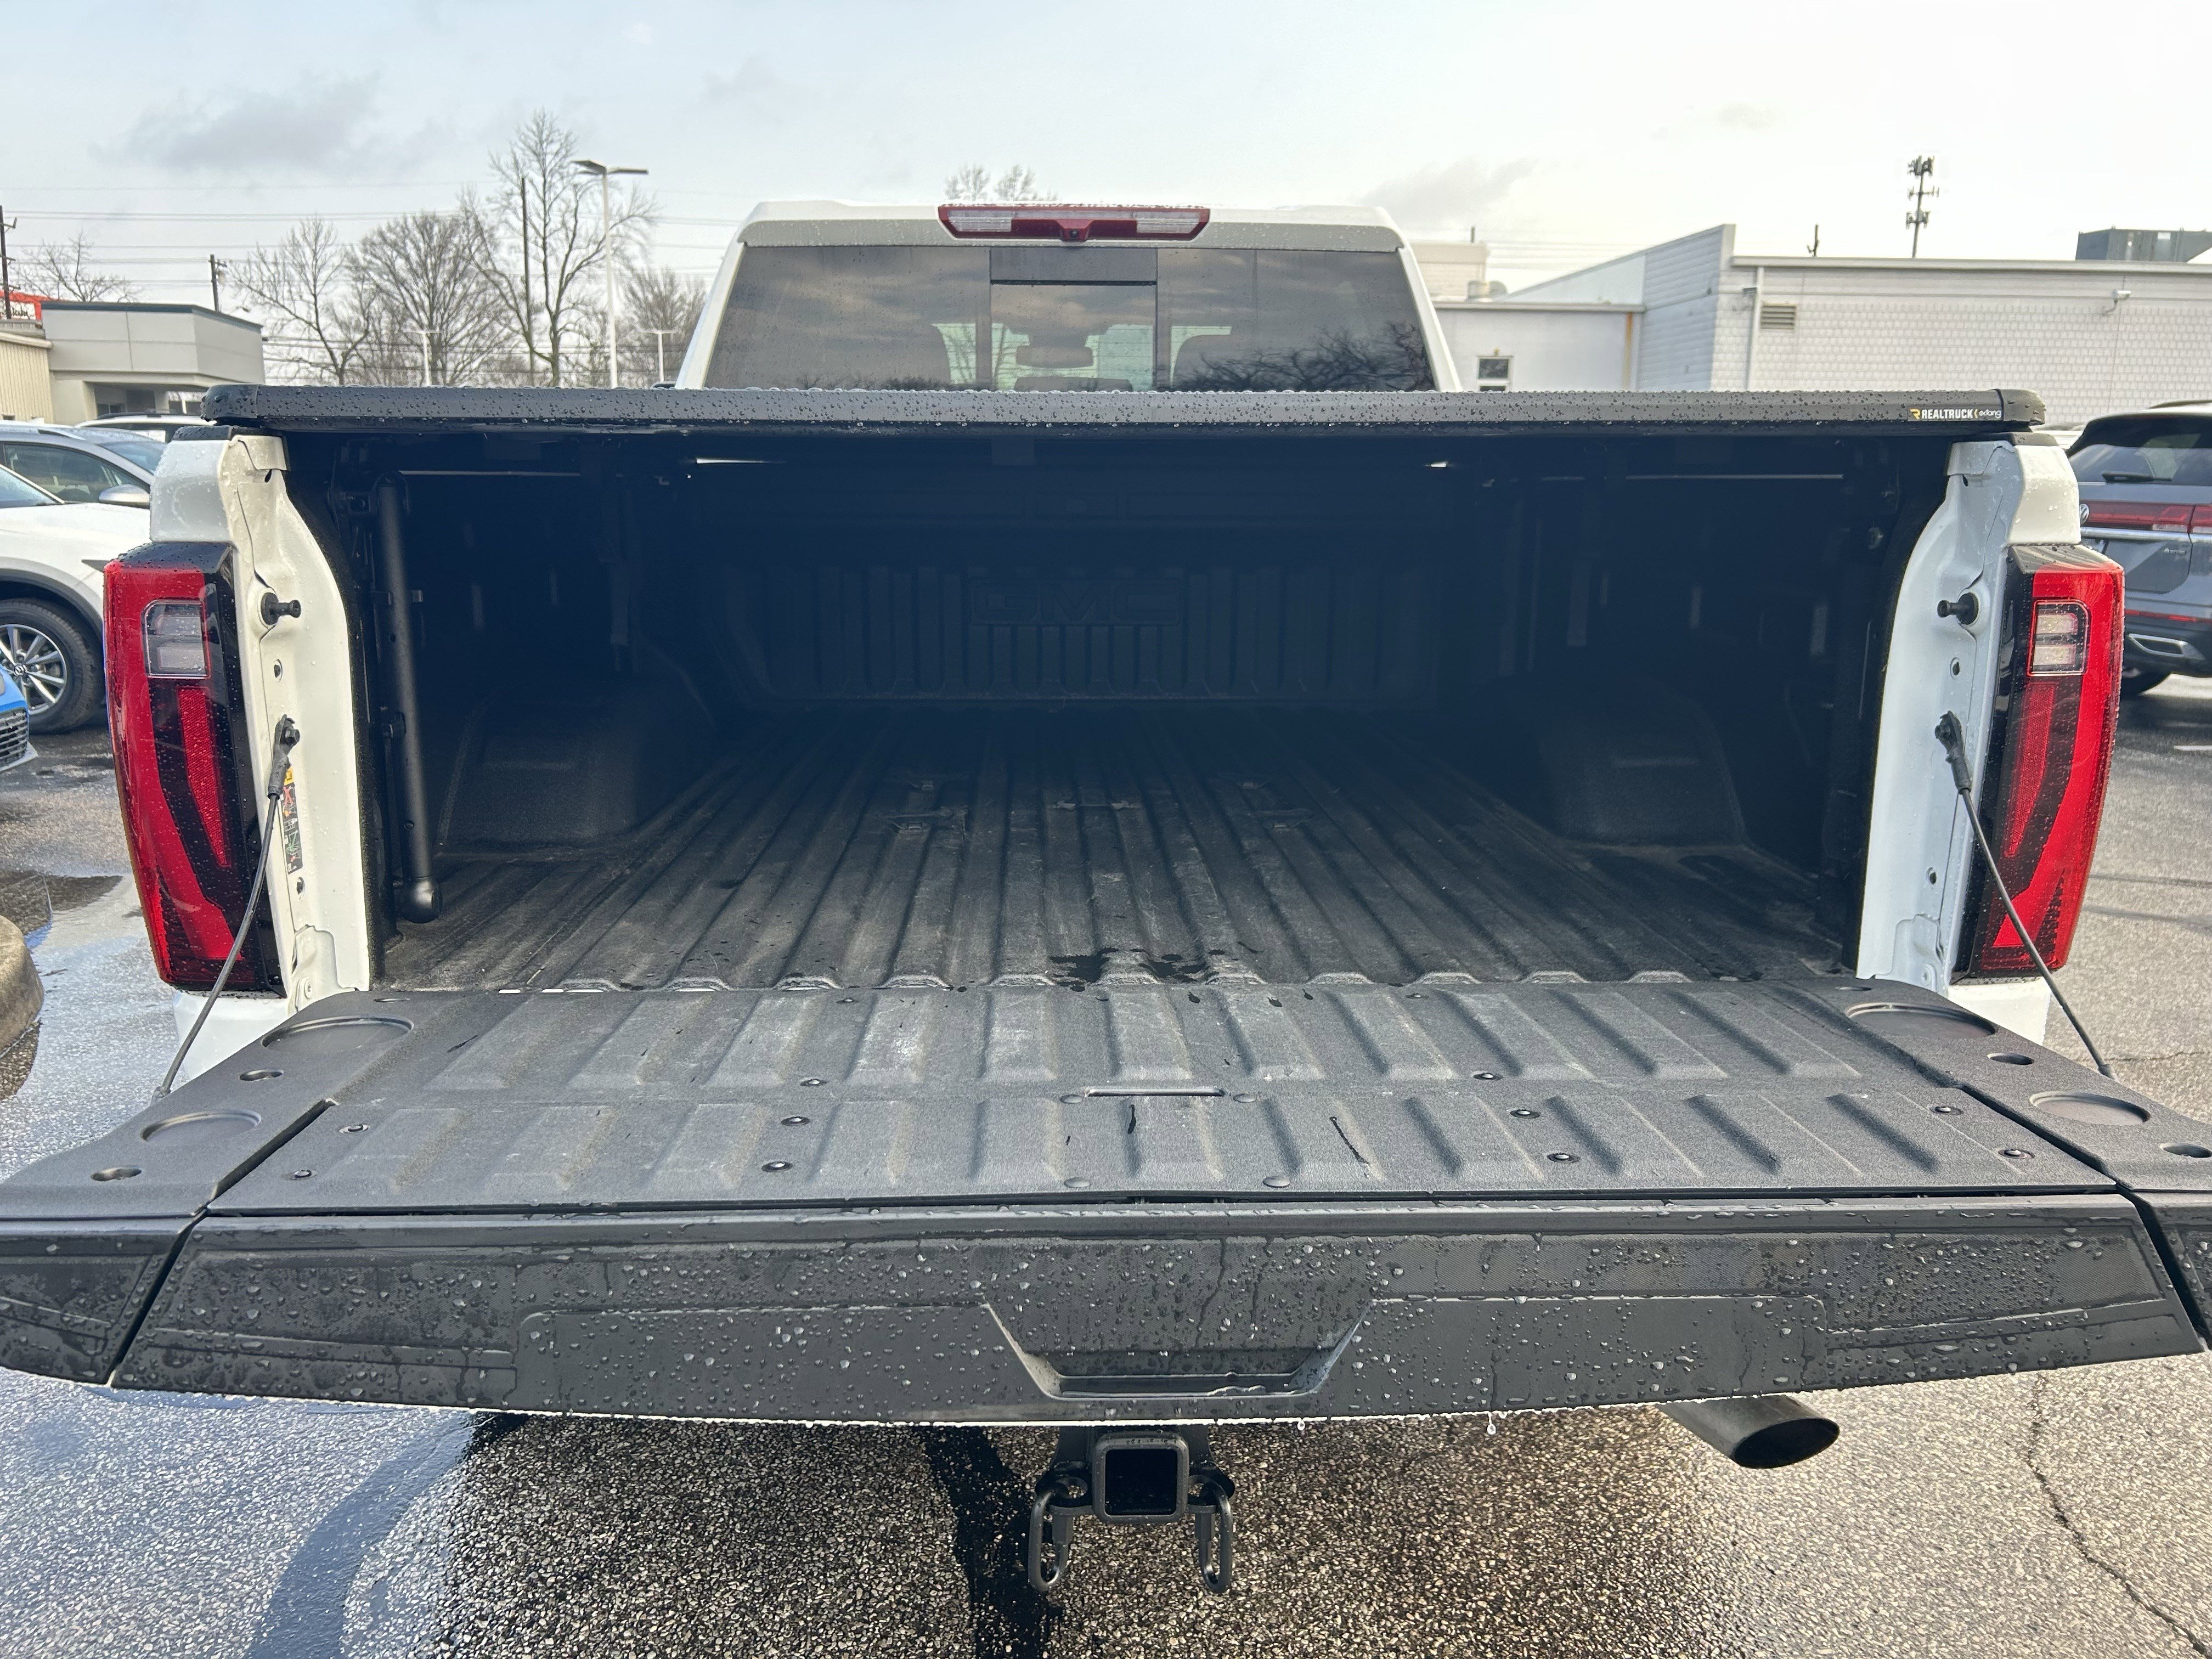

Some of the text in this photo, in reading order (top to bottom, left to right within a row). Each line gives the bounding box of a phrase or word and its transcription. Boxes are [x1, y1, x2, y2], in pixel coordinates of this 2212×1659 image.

[1921, 409, 1973, 419] REALTRUCK
[1979, 409, 2002, 419] extang
[973, 583, 1179, 622] GMC
